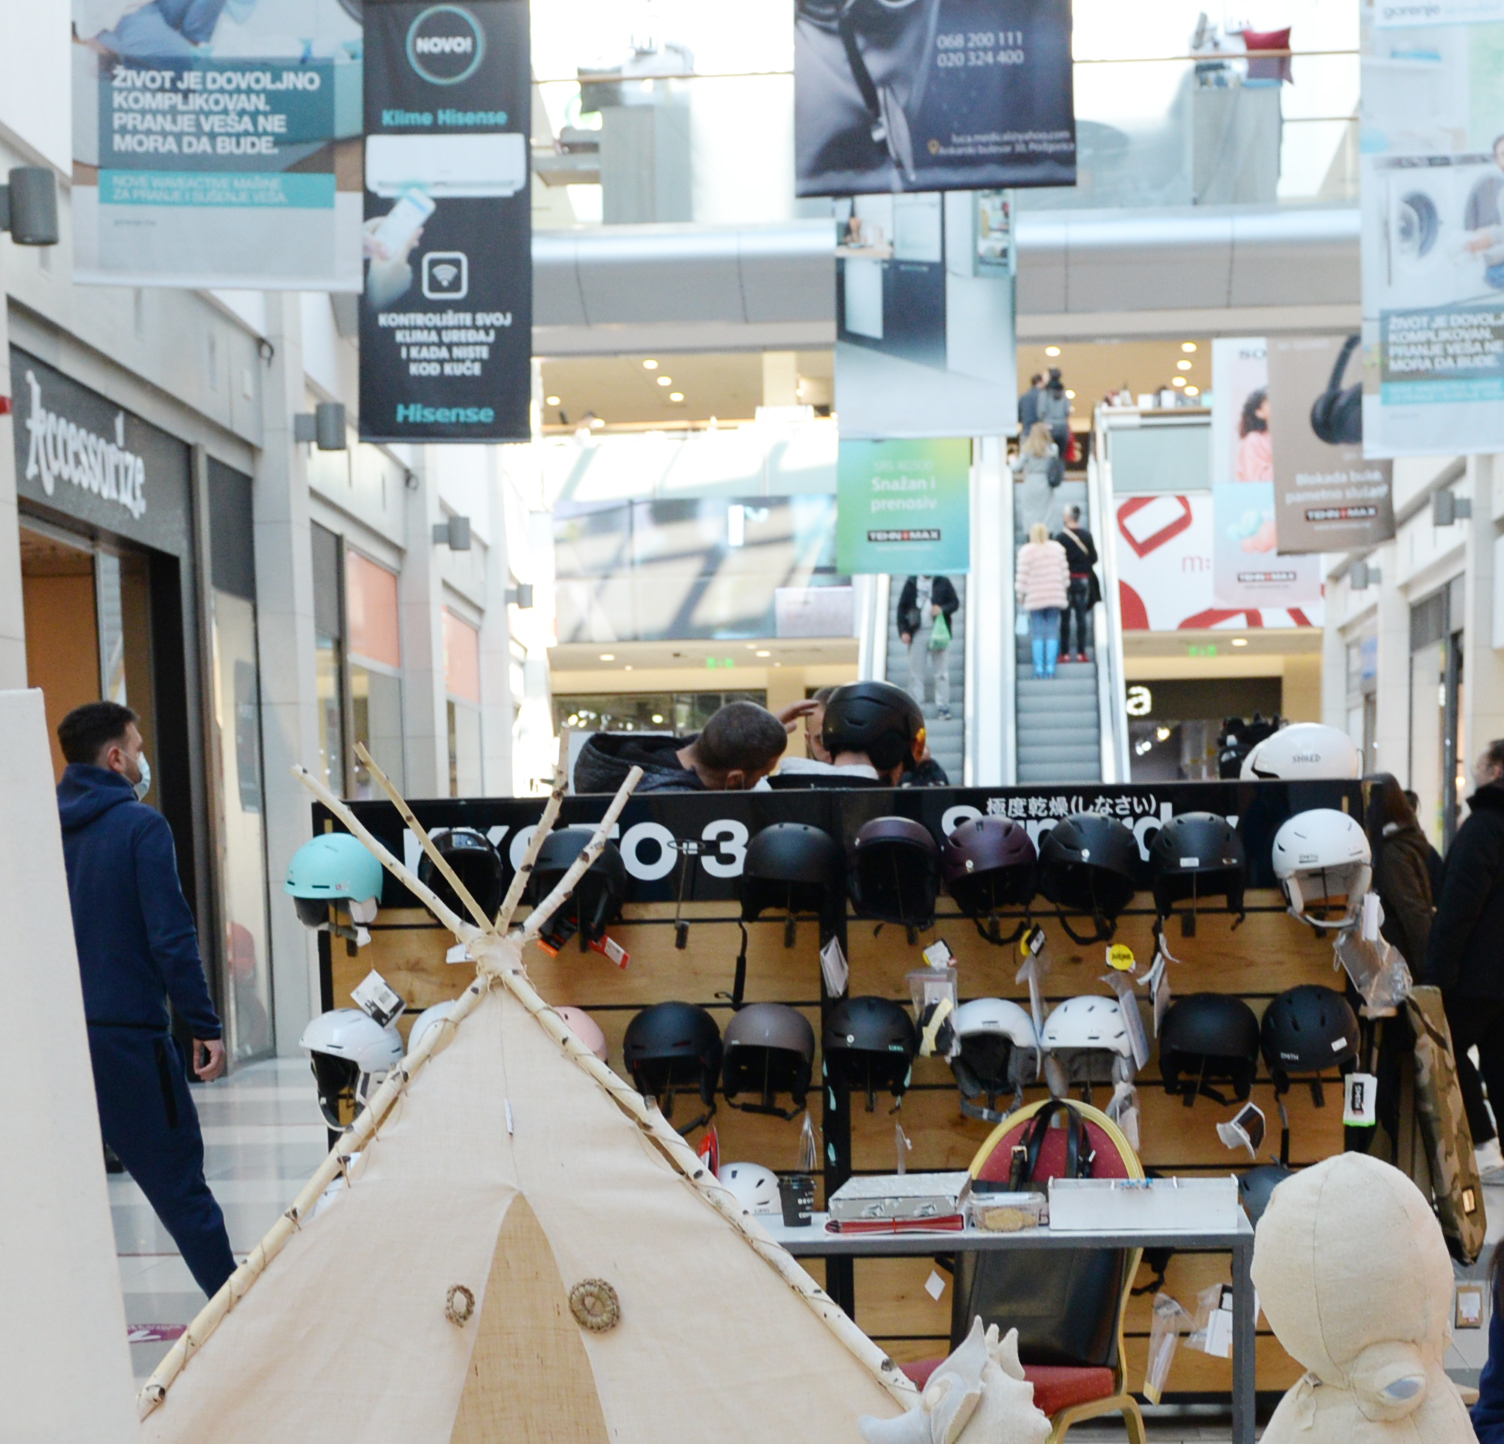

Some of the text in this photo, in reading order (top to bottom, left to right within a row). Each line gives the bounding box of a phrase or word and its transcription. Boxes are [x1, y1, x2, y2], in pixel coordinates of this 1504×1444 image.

[1383, 2, 1441, 19] gorenje
[415, 35, 473, 54] NOVO!
[967, 32, 995, 48] 200
[998, 31, 1023, 46] 111
[937, 49, 1025, 67] 020 324 400
[112, 64, 322, 91] ŽIVOT JE DOVOLJNO
[112, 91, 271, 112] KOMPLIKOVAN.
[112, 108, 288, 133] PRANJE VEŠA NE
[437, 109, 509, 126] Hisense
[112, 133, 280, 154] MORA DA BUDE.
[475, 312, 512, 327] SVOJ
[395, 329, 440, 344] KLIMA
[410, 345, 451, 360] KADA
[409, 362, 441, 376] KOD
[396, 402, 495, 424] Hisense
[25, 369, 147, 520] Accessorize
[871, 475, 928, 492] Snažan
